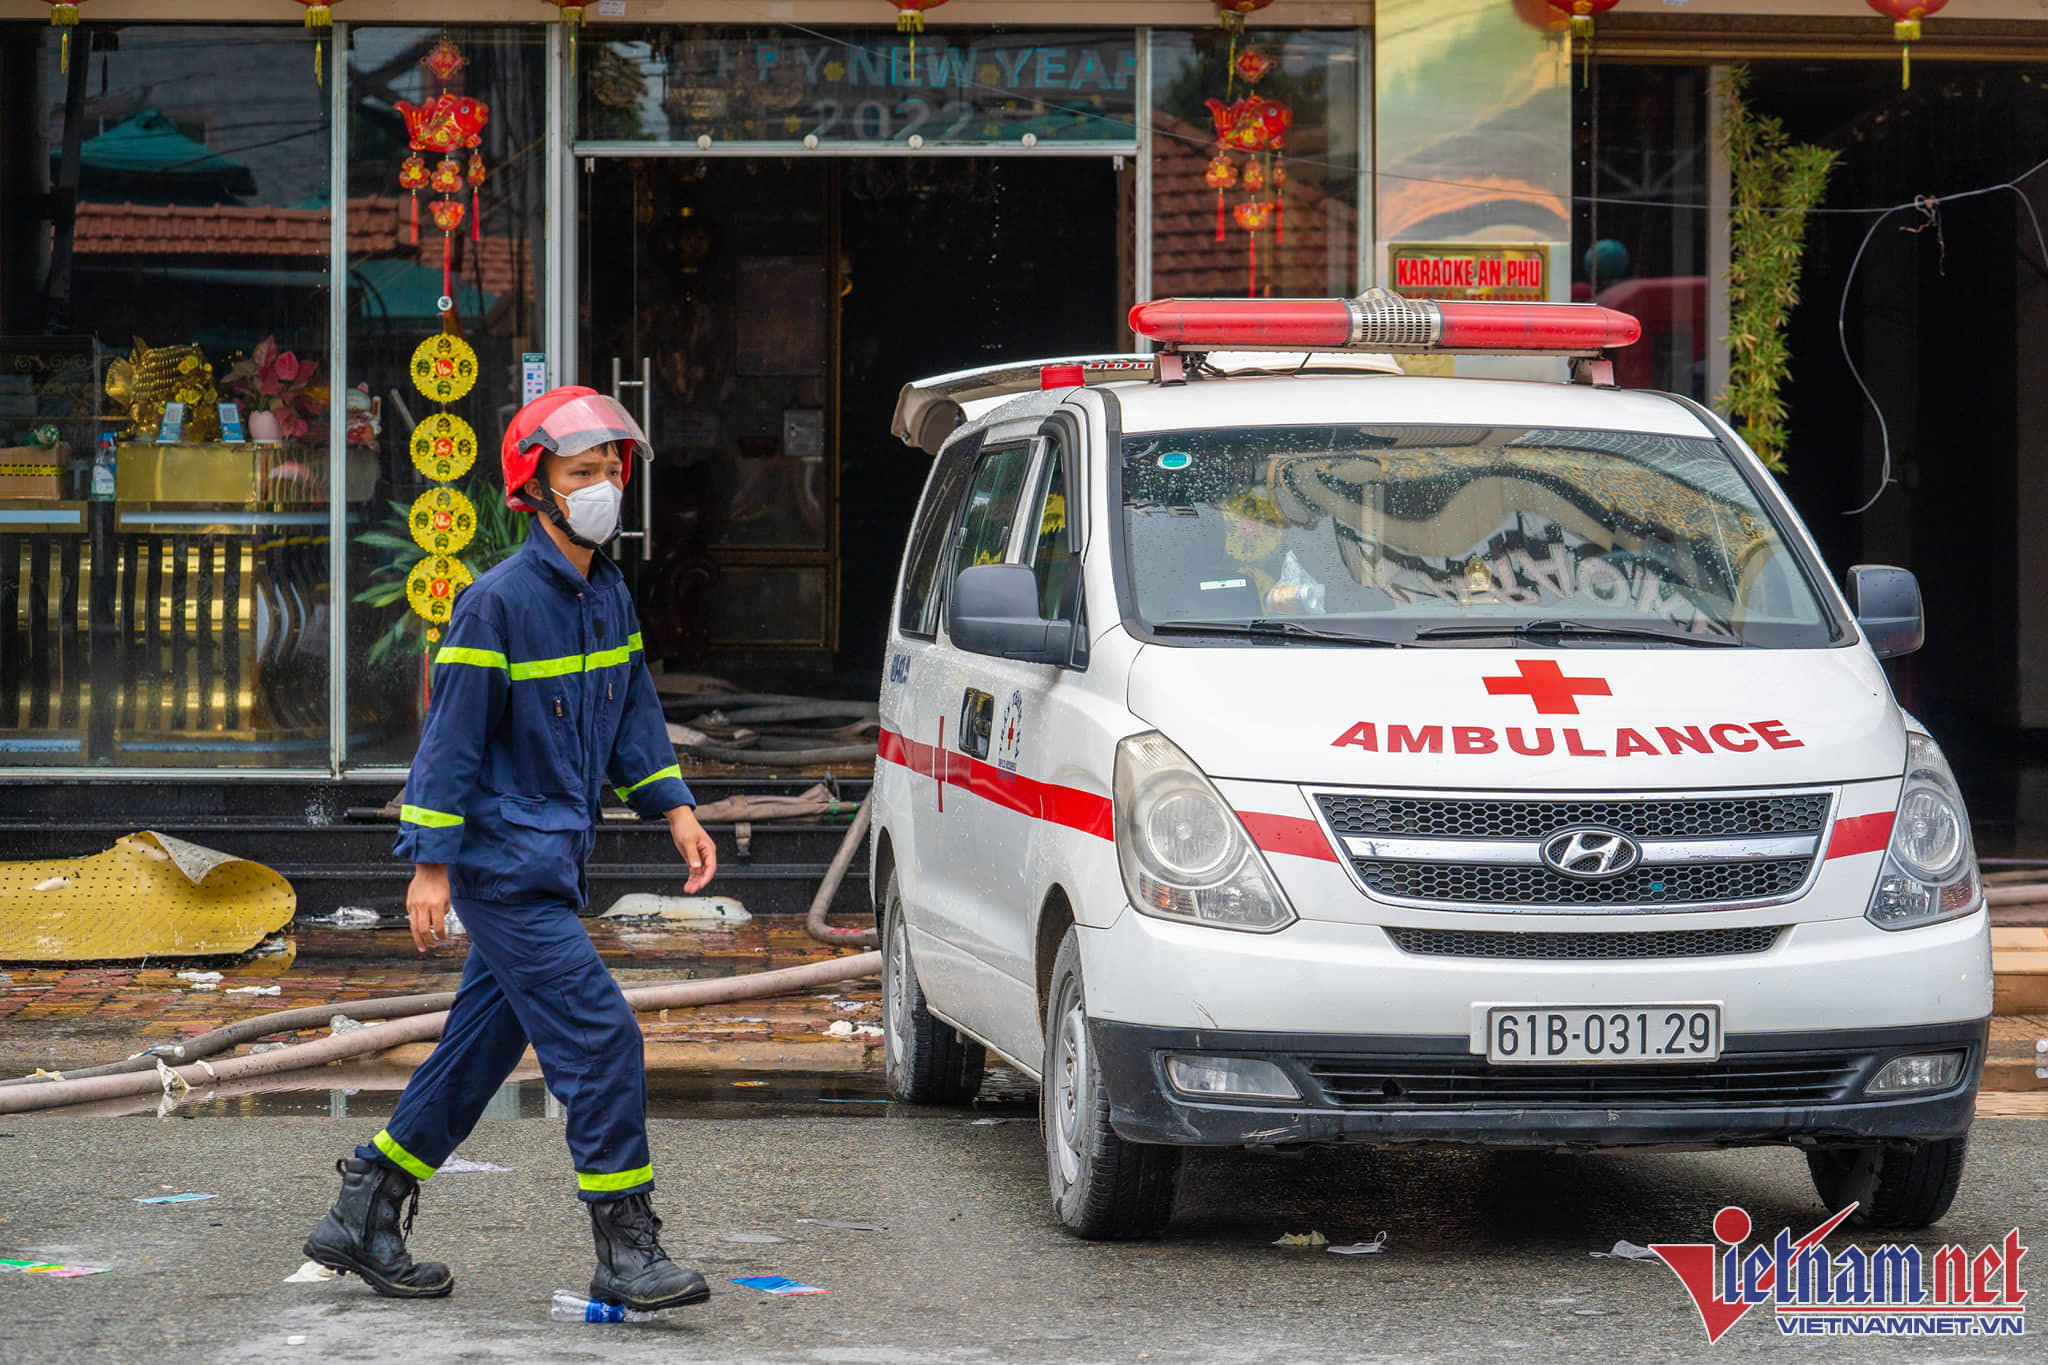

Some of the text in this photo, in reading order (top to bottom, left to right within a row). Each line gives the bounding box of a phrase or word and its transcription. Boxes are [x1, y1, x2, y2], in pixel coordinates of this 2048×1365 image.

[847, 45, 979, 88] NEW
[1397, 254, 1541, 287] KARAOKE AN PHÚ
[1331, 720, 1805, 757] AMBULANCE
[1498, 1012, 1709, 1055] 61B-031.29
